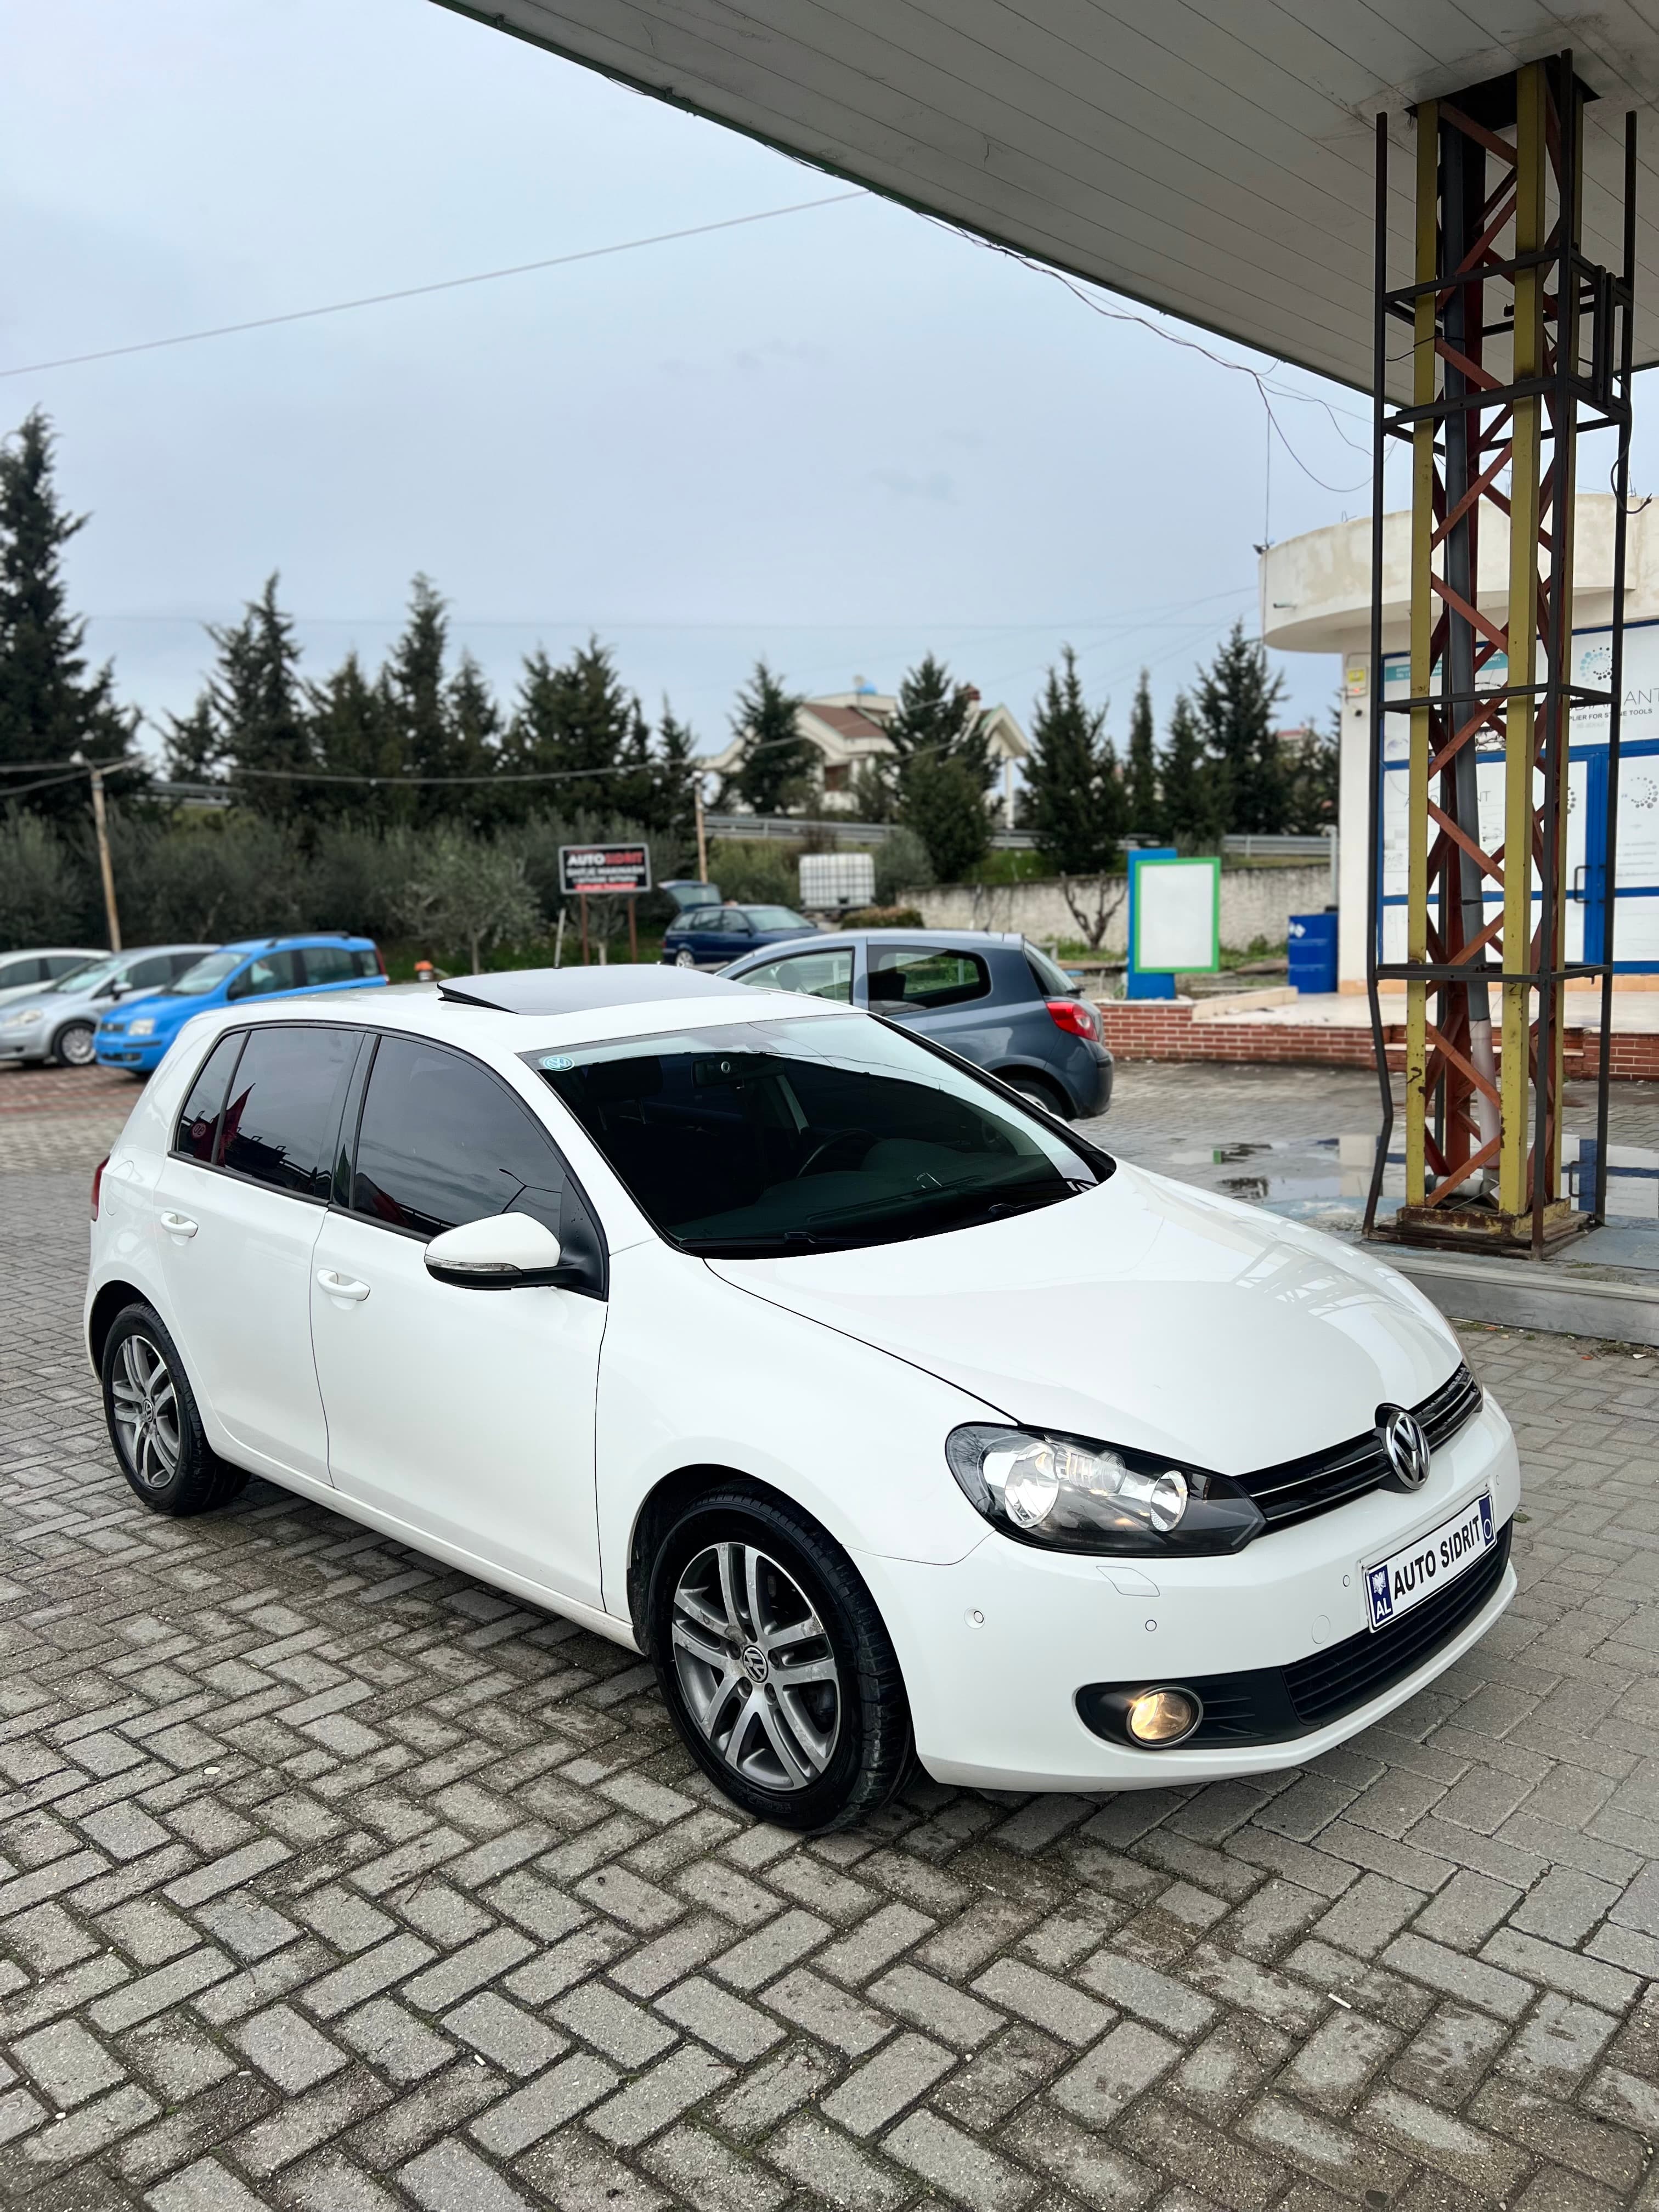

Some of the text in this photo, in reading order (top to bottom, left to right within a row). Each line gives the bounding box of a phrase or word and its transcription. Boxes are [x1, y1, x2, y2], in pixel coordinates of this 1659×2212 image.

[567, 853, 605, 866] AUTO
[1394, 1514, 1480, 1600] AUTO SIDRIT
[1376, 1597, 1392, 1620] AL
